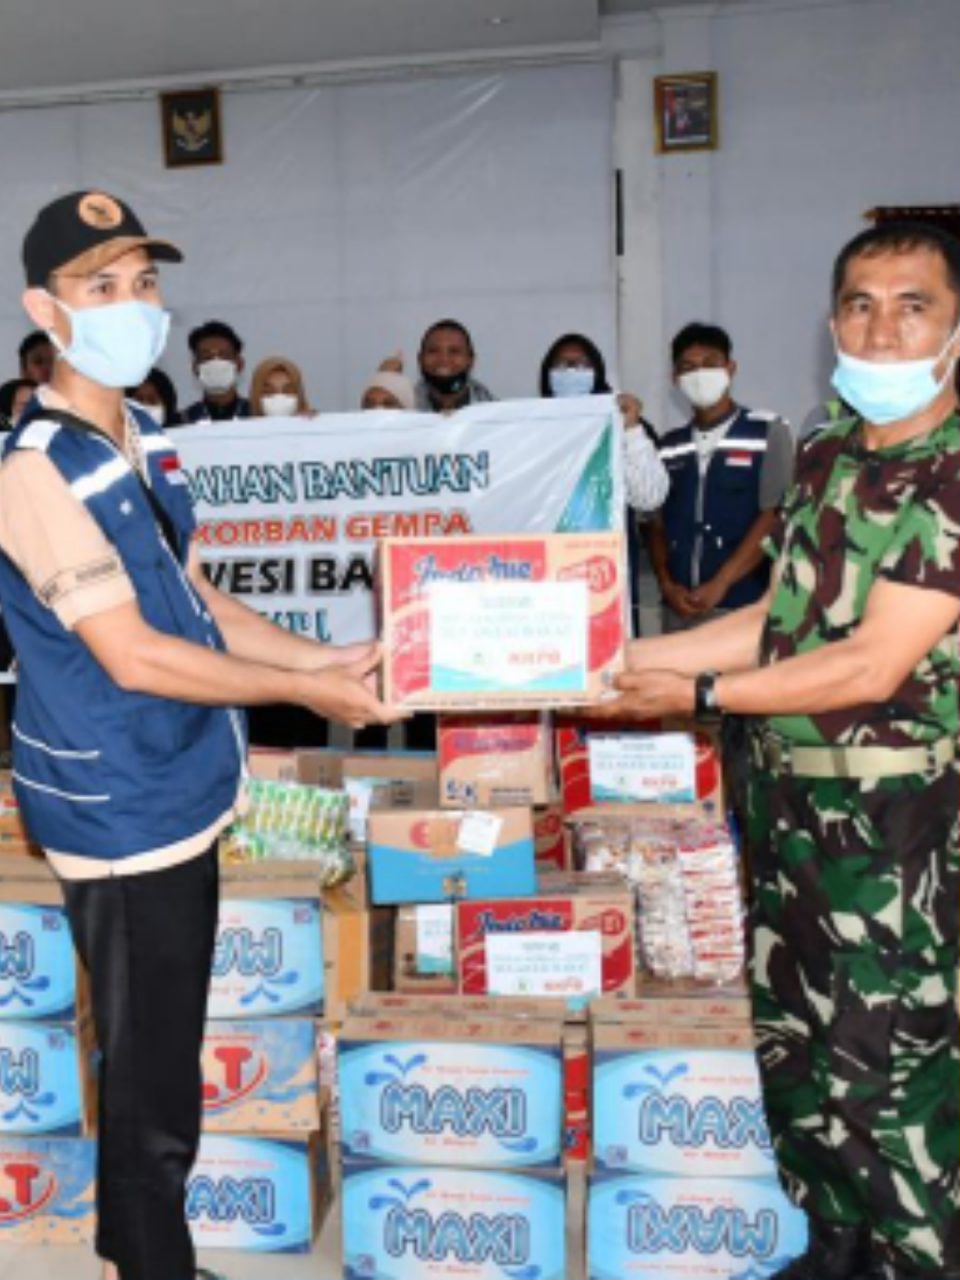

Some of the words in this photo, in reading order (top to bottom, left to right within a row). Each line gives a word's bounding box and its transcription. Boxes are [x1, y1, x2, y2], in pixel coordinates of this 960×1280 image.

[183, 463, 298, 506] AHAN
[299, 450, 490, 500] BANTUAN
[344, 509, 473, 539] GEMPA
[379, 1080, 527, 1137] MAXI
[383, 1206, 531, 1266] MAXI
[627, 1204, 779, 1258] MAXI
